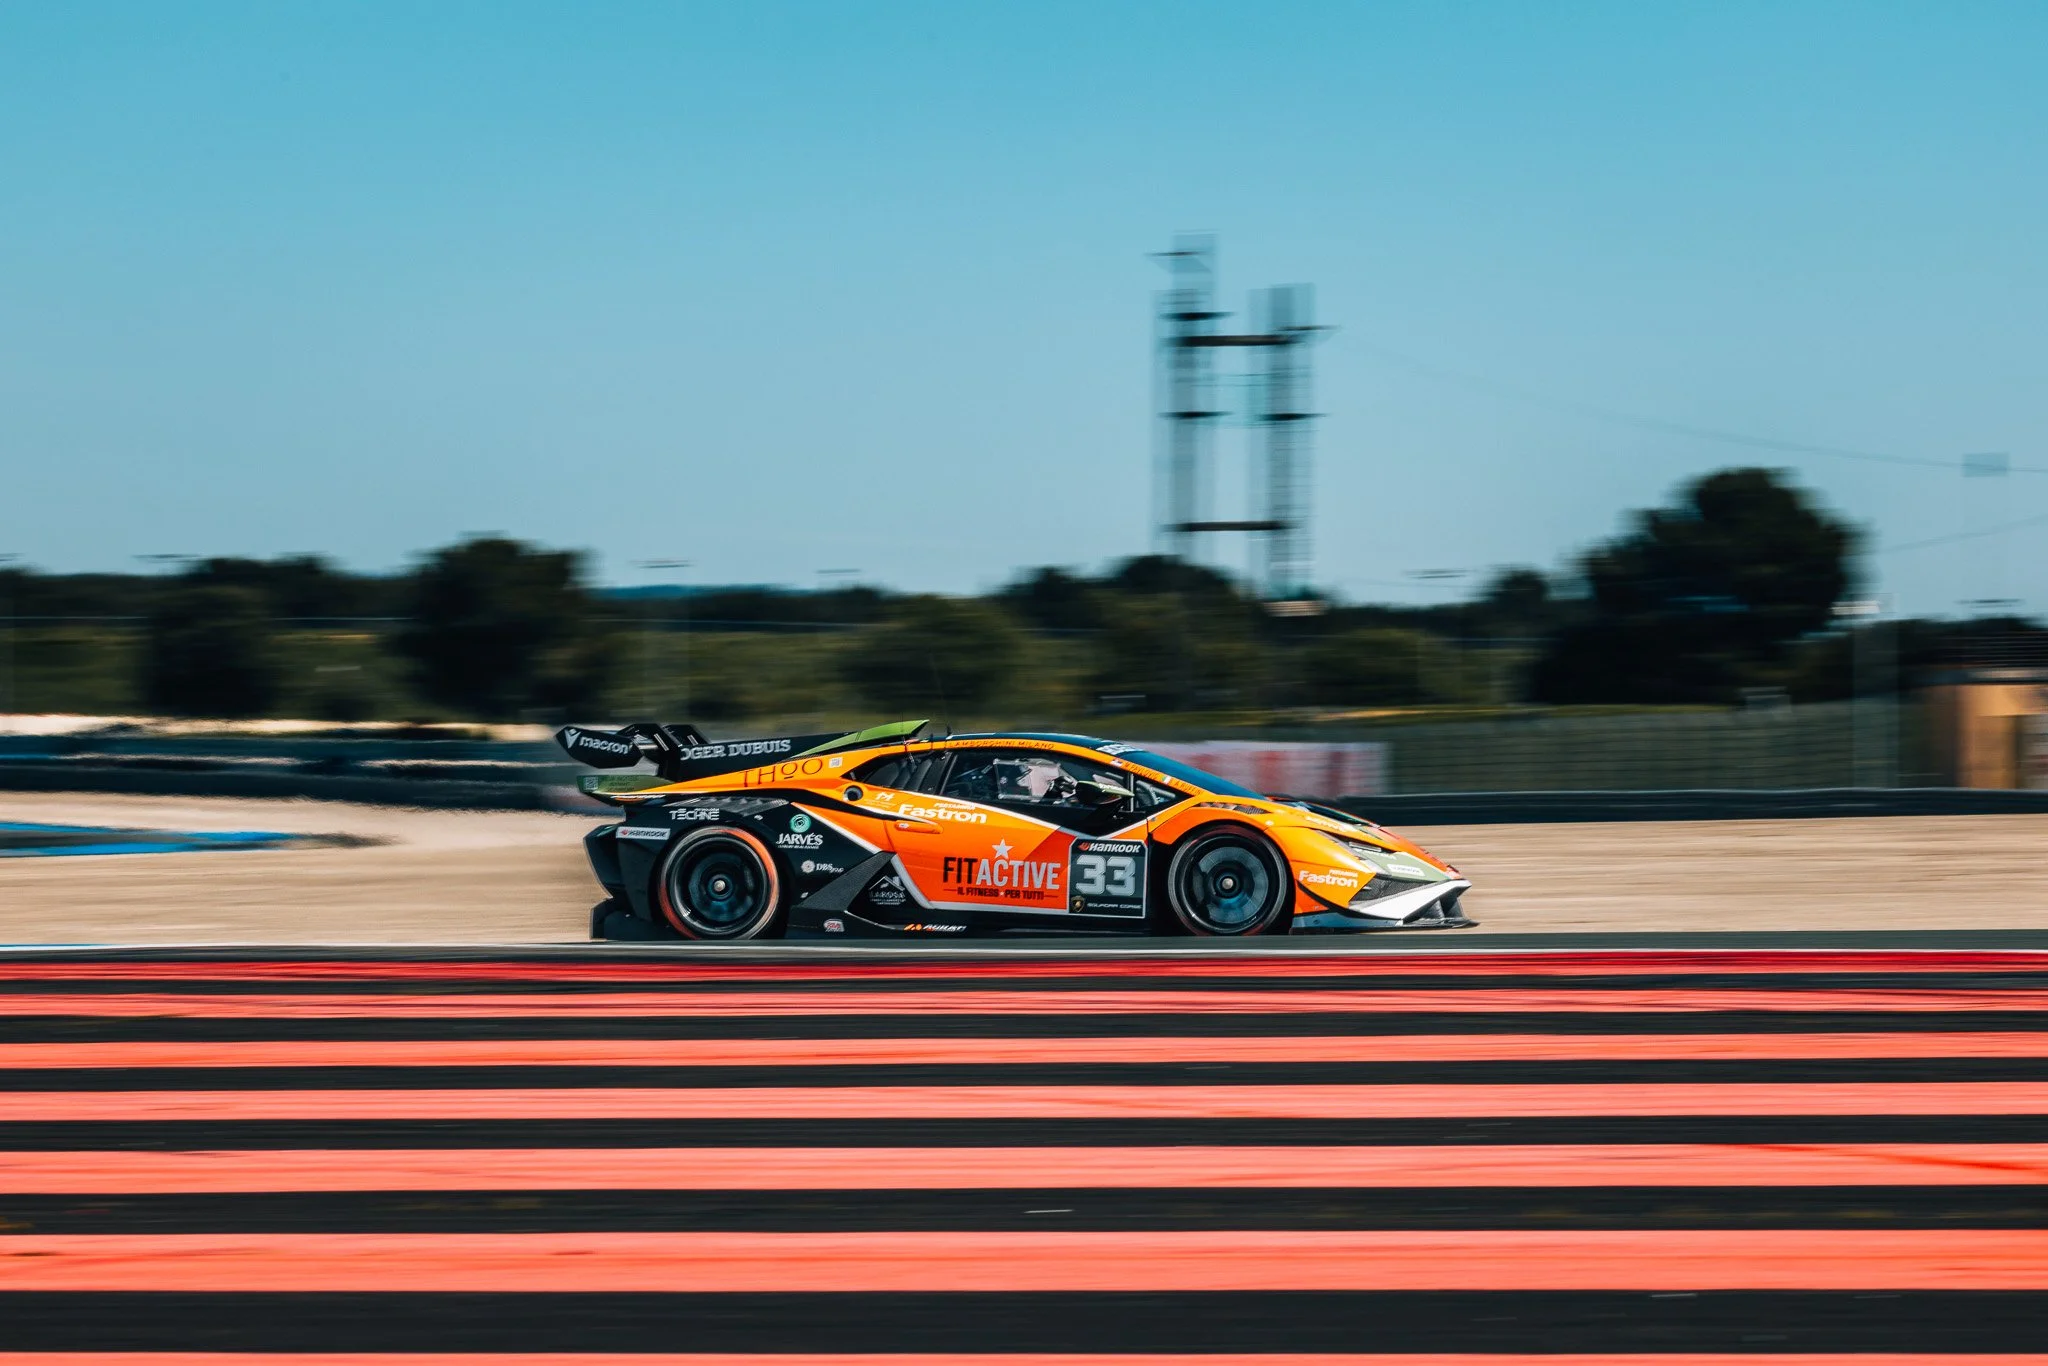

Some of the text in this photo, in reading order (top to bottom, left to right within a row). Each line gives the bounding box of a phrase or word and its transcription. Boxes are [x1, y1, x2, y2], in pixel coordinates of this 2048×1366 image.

[580, 736, 628, 754] macron
[680, 739, 791, 760] OGER DUBUIS
[898, 804, 987, 824] Fastron
[943, 857, 1061, 890] FITACTIVE
[1076, 854, 1136, 896] 33
[1299, 870, 1358, 888] Fastron
[957, 887, 965, 896] IL
[966, 887, 999, 898] FITNESS
[1004, 889, 1021, 899] PER
